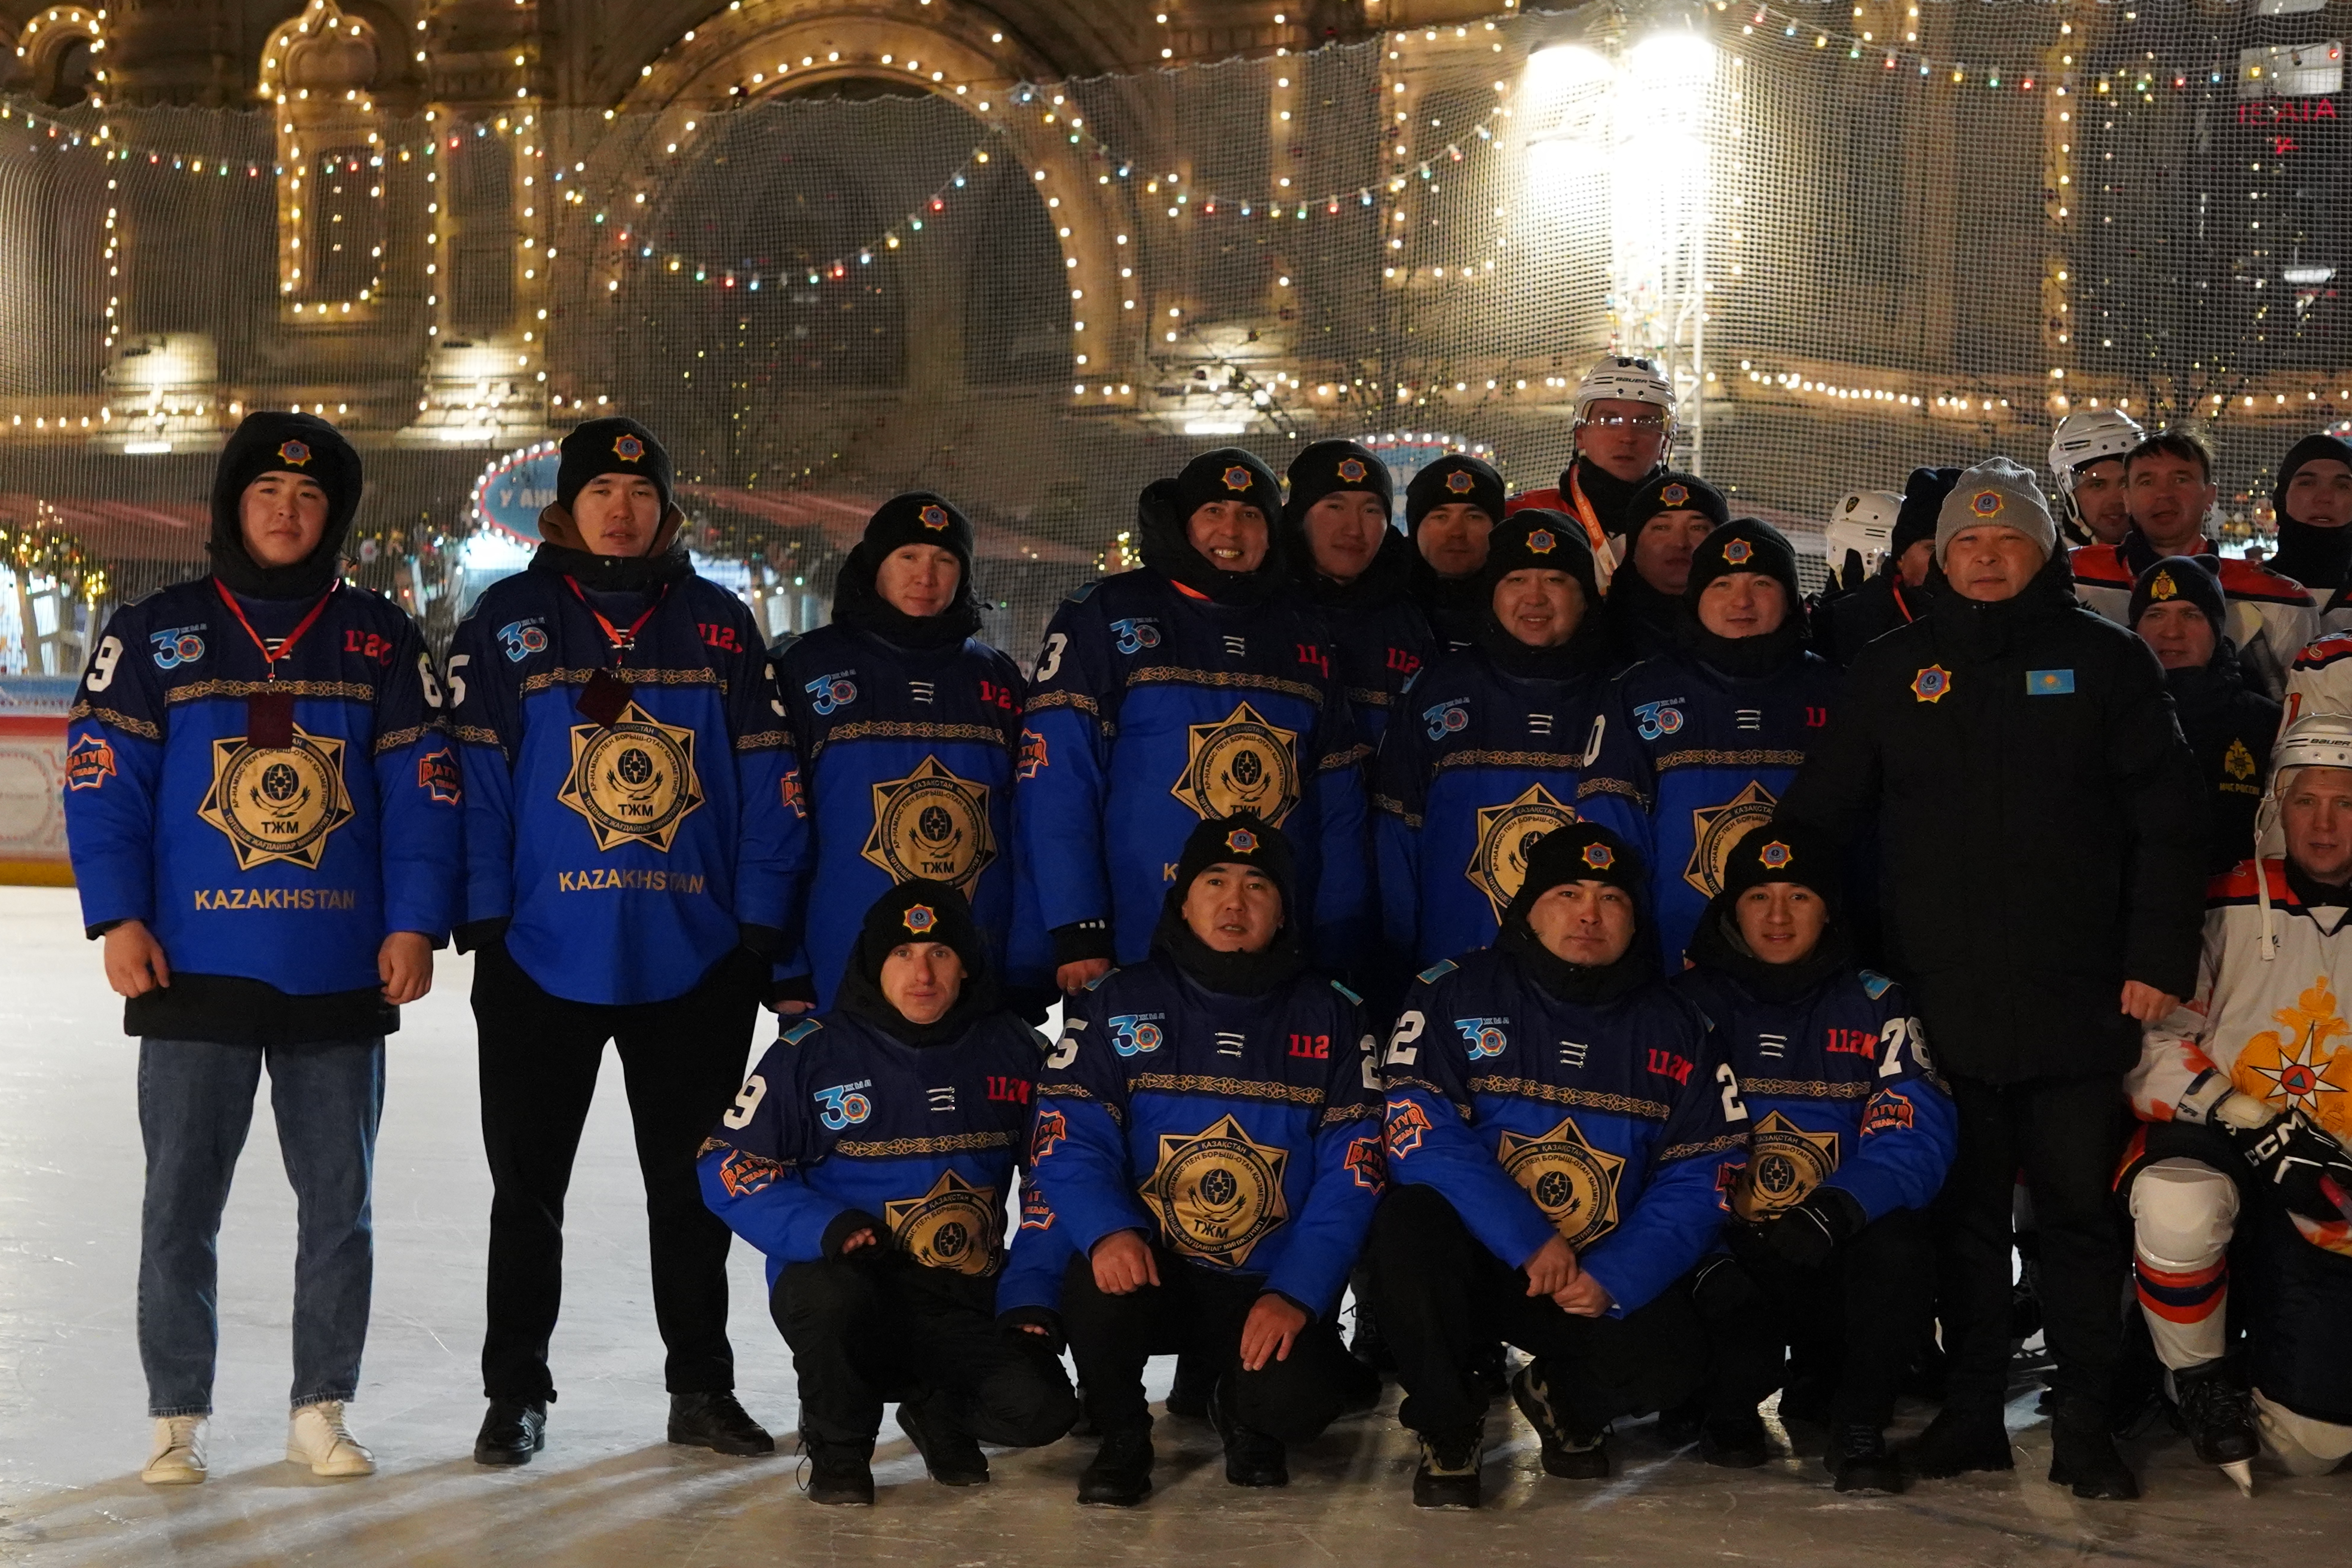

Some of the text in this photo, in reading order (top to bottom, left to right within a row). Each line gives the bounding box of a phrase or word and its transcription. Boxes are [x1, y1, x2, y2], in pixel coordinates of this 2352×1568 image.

[86, 635, 123, 692] 9
[1036, 632, 1068, 682] 3
[418, 652, 443, 708] 6
[447, 654, 471, 709] 5
[2310, 738, 2351, 747] BAUER
[261, 821, 299, 834] ТЖМ
[618, 804, 653, 817] ТЖМ
[1518, 816, 1561, 828] БОРЫШ-ОТА
[558, 868, 705, 895] KAZAKHSTAN
[920, 861, 954, 874] ТЖМ
[194, 889, 356, 911] KAZAKHSTAN
[1047, 1017, 1089, 1069] 5
[1288, 1034, 1330, 1059] 112
[1359, 1034, 1385, 1092] 2
[723, 1074, 767, 1131] 9
[1716, 1062, 1748, 1122] 2
[2244, 1111, 2308, 1167] CCM
[1194, 1219, 1229, 1238] ТЖМ
